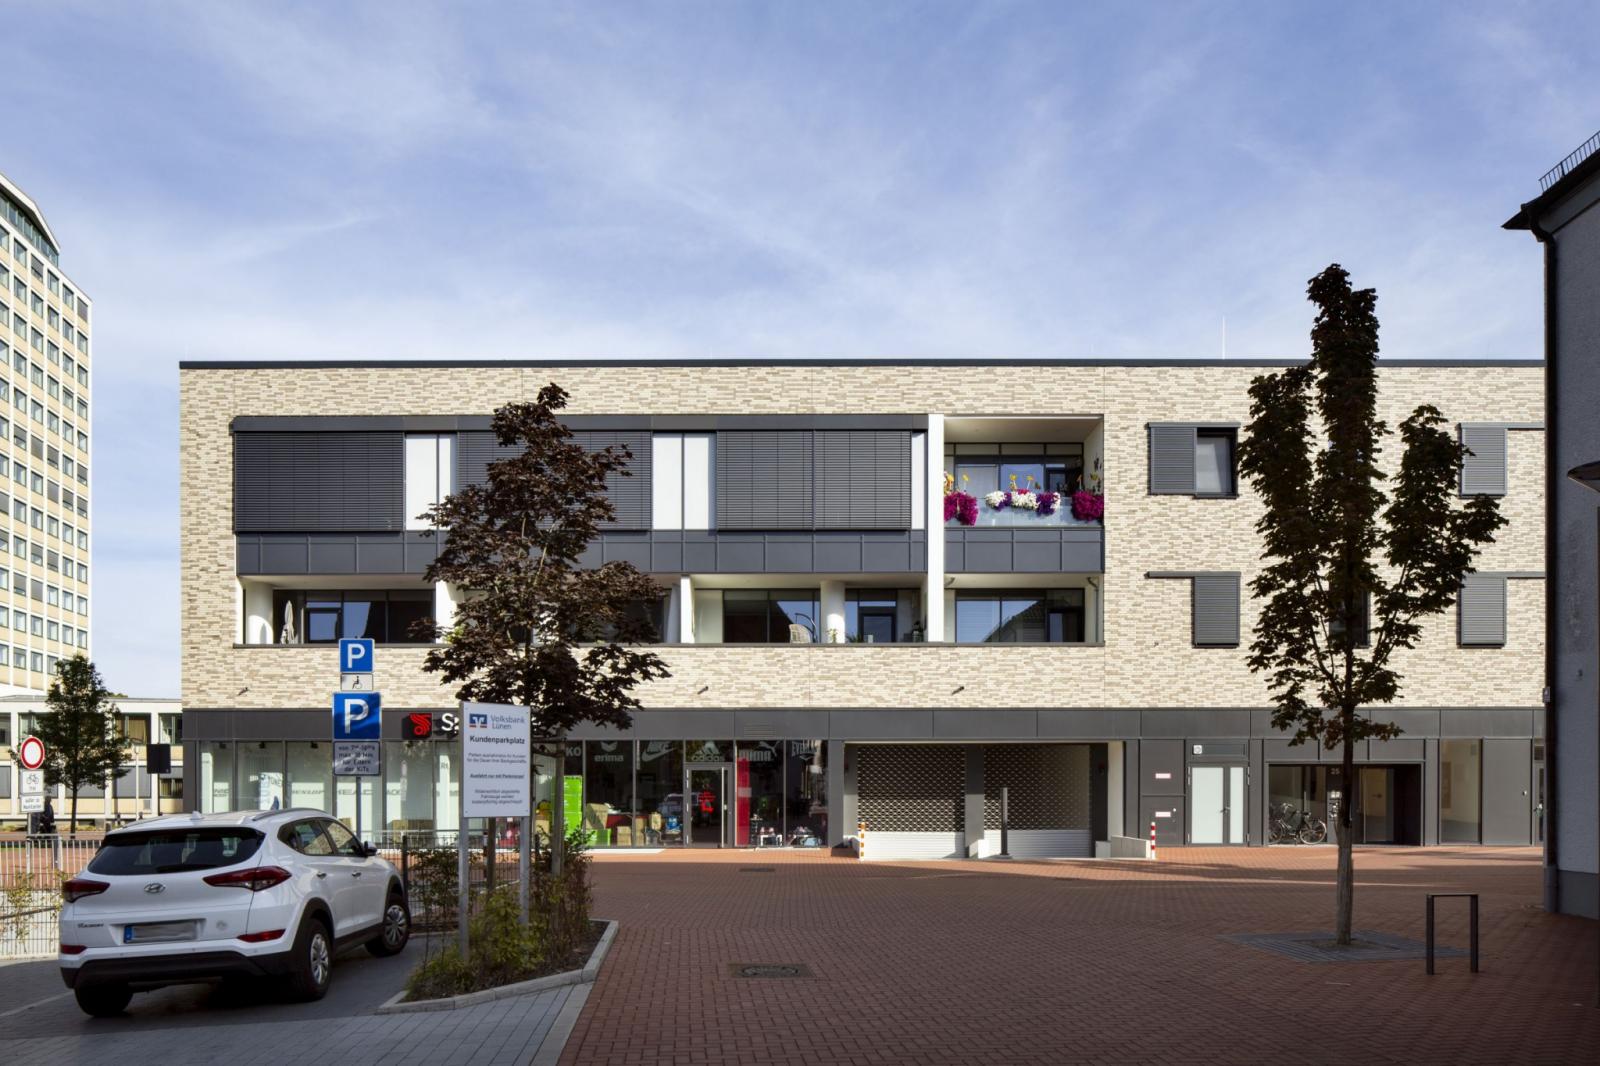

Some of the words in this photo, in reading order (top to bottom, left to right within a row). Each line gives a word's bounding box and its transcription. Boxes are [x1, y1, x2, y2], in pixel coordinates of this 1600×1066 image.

[347, 643, 366, 669] P
[344, 698, 369, 734] P
[491, 714, 525, 724] Volksbank
[470, 735, 525, 745] Kundenparkplatz
[594, 753, 624, 763] erima
